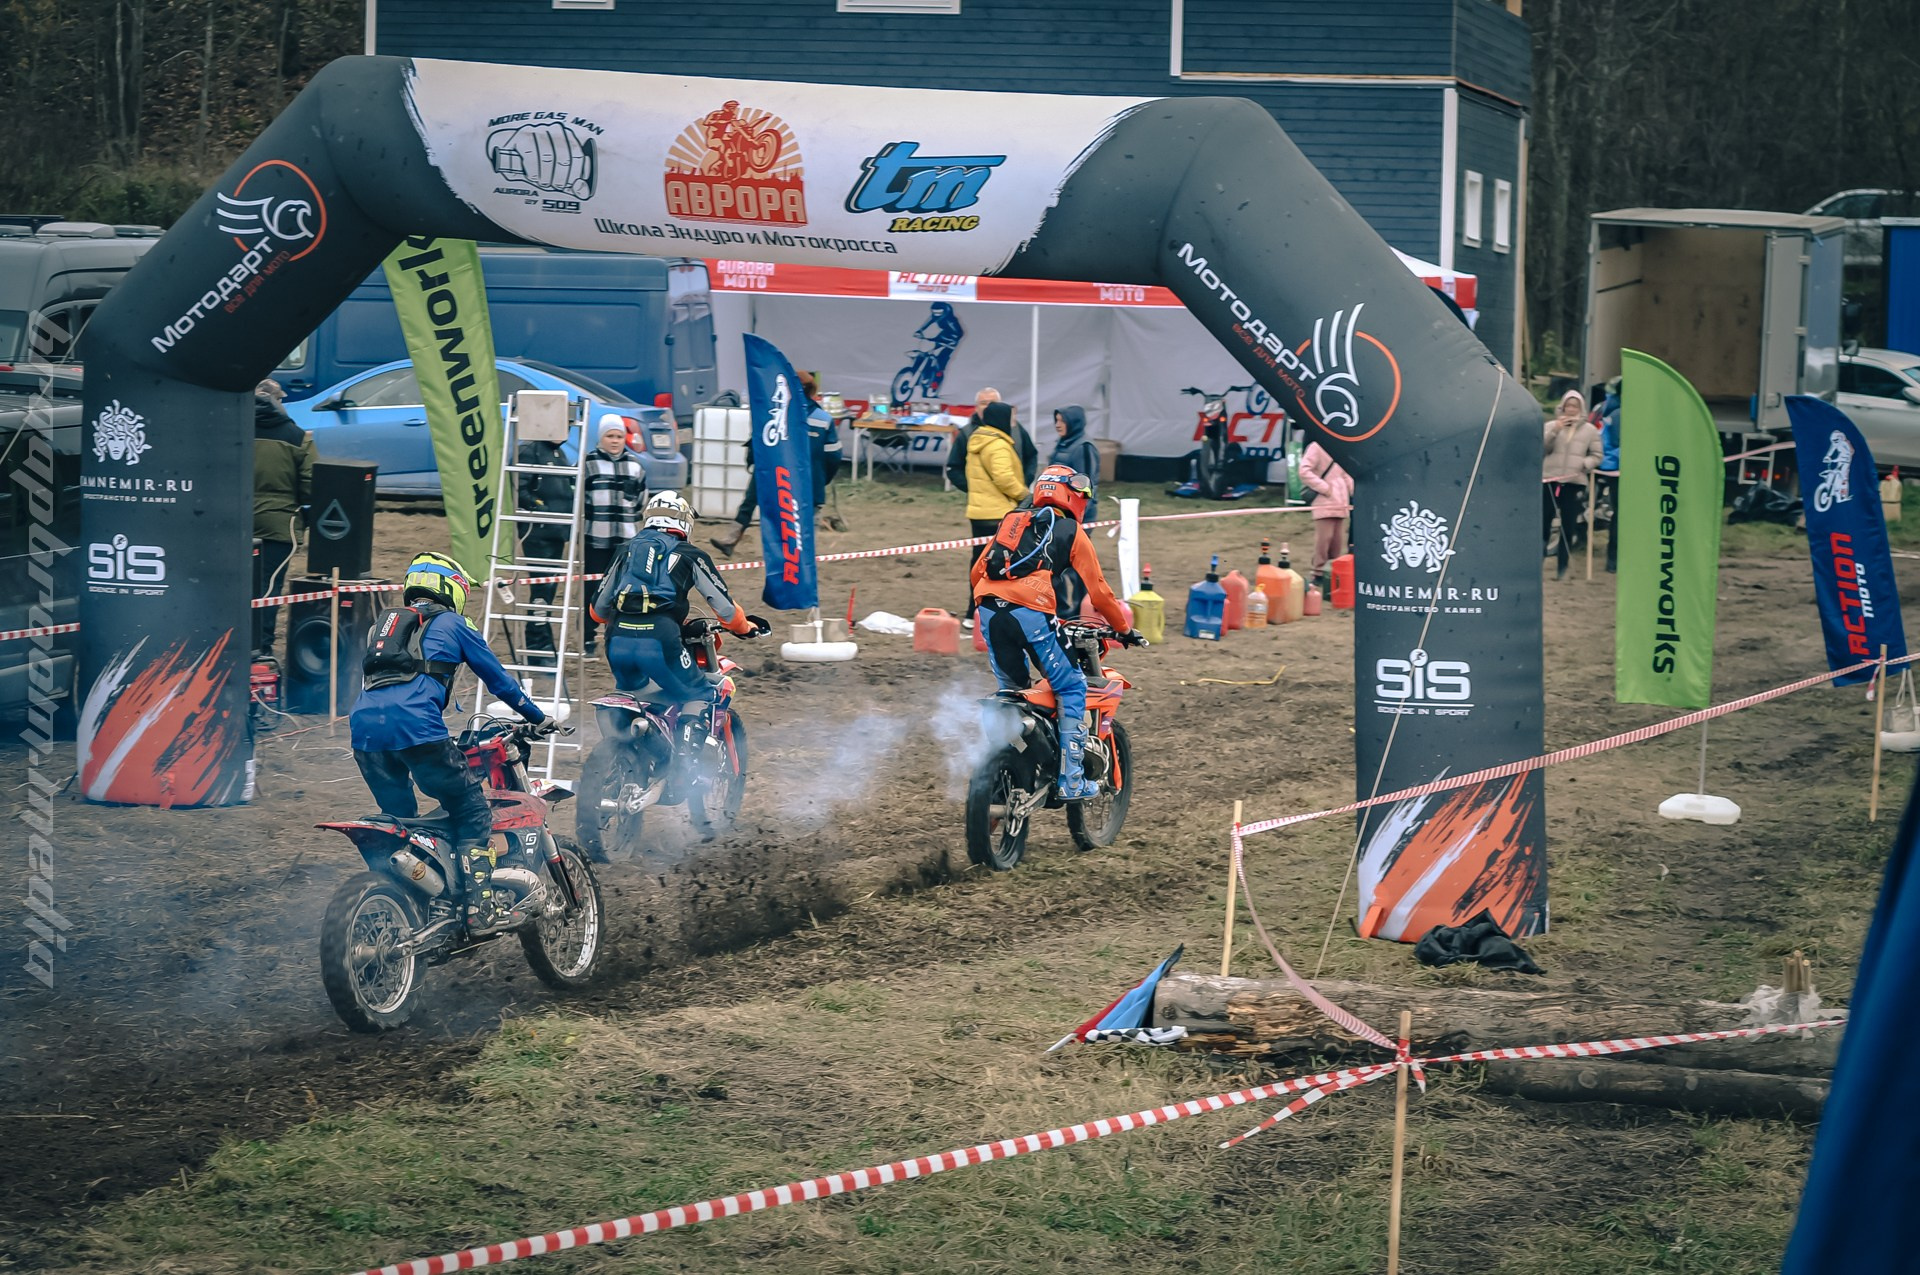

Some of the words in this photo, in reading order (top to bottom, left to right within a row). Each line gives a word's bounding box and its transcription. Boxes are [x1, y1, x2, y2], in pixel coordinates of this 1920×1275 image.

[488, 112, 532, 127] MORE
[570, 117, 604, 135] MAN
[493, 187, 539, 197] AURORA
[666, 180, 806, 223] АВРОРА
[542, 199, 580, 211] 509
[593, 217, 666, 238] Школа
[668, 223, 744, 246] Эндуро
[748, 231, 764, 246] и
[763, 230, 898, 254] Мотокросса
[887, 215, 980, 233] RACING
[717, 260, 775, 276] AURORA
[723, 274, 768, 289] MOTO
[151, 236, 273, 353] Мотодарт
[1099, 287, 1145, 302] MOTO
[1177, 243, 1317, 381] Мотодарт
[776, 466, 799, 585] ACTION
[1652, 455, 1681, 674] greenworks
[1830, 532, 1870, 655] ACTION
[1434, 708, 1471, 716] SPORT
